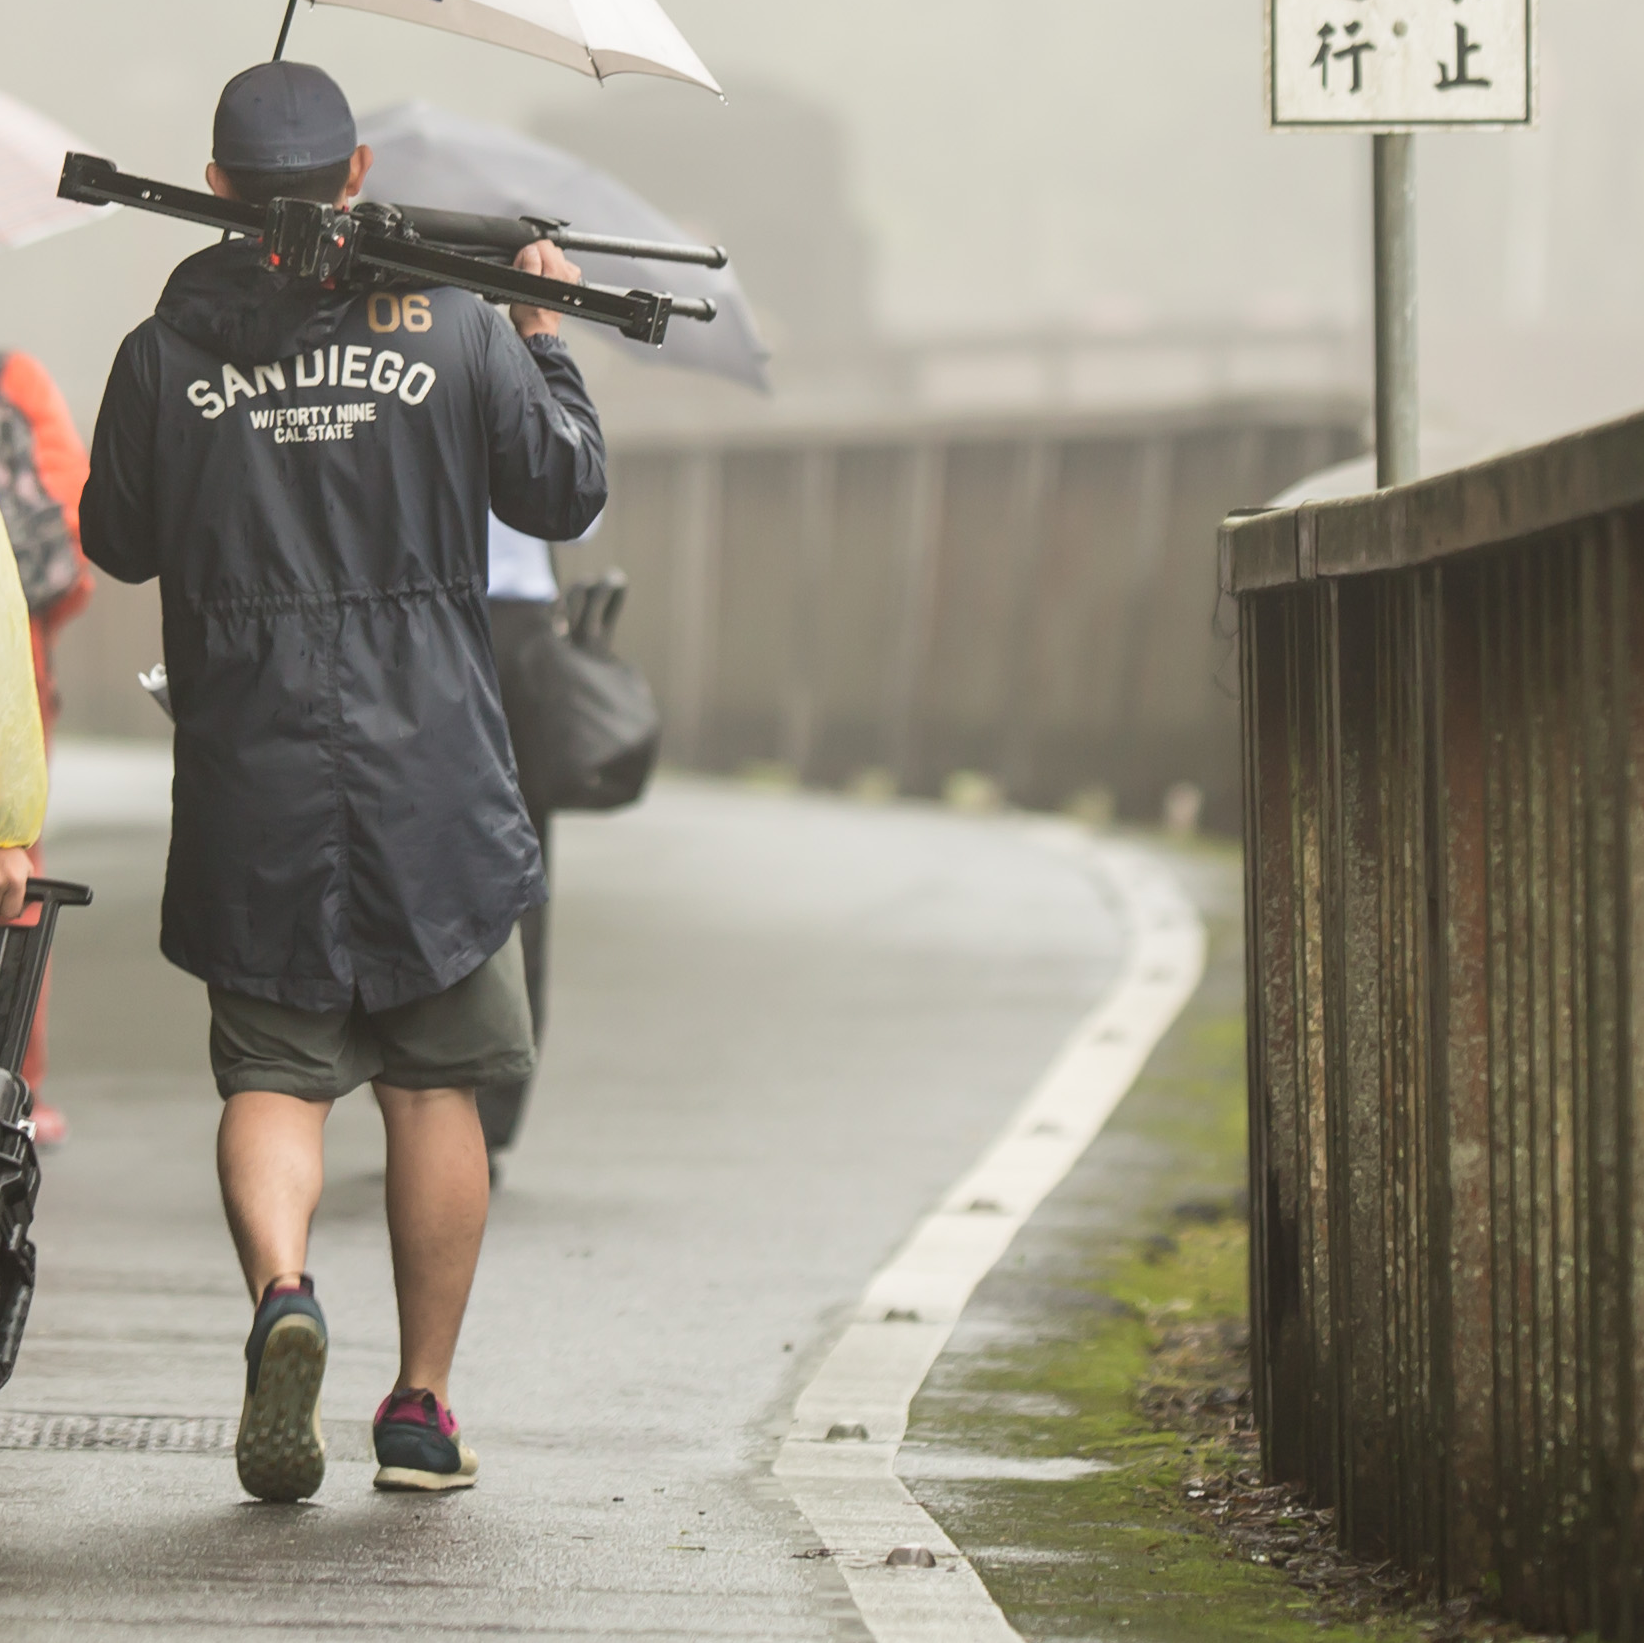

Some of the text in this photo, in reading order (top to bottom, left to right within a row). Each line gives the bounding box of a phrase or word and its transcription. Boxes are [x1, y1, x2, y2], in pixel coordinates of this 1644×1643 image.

[367, 292, 434, 334] 06
[186, 344, 437, 420] SAN DIEGO
[249, 402, 377, 430] W/FORTY NINE
